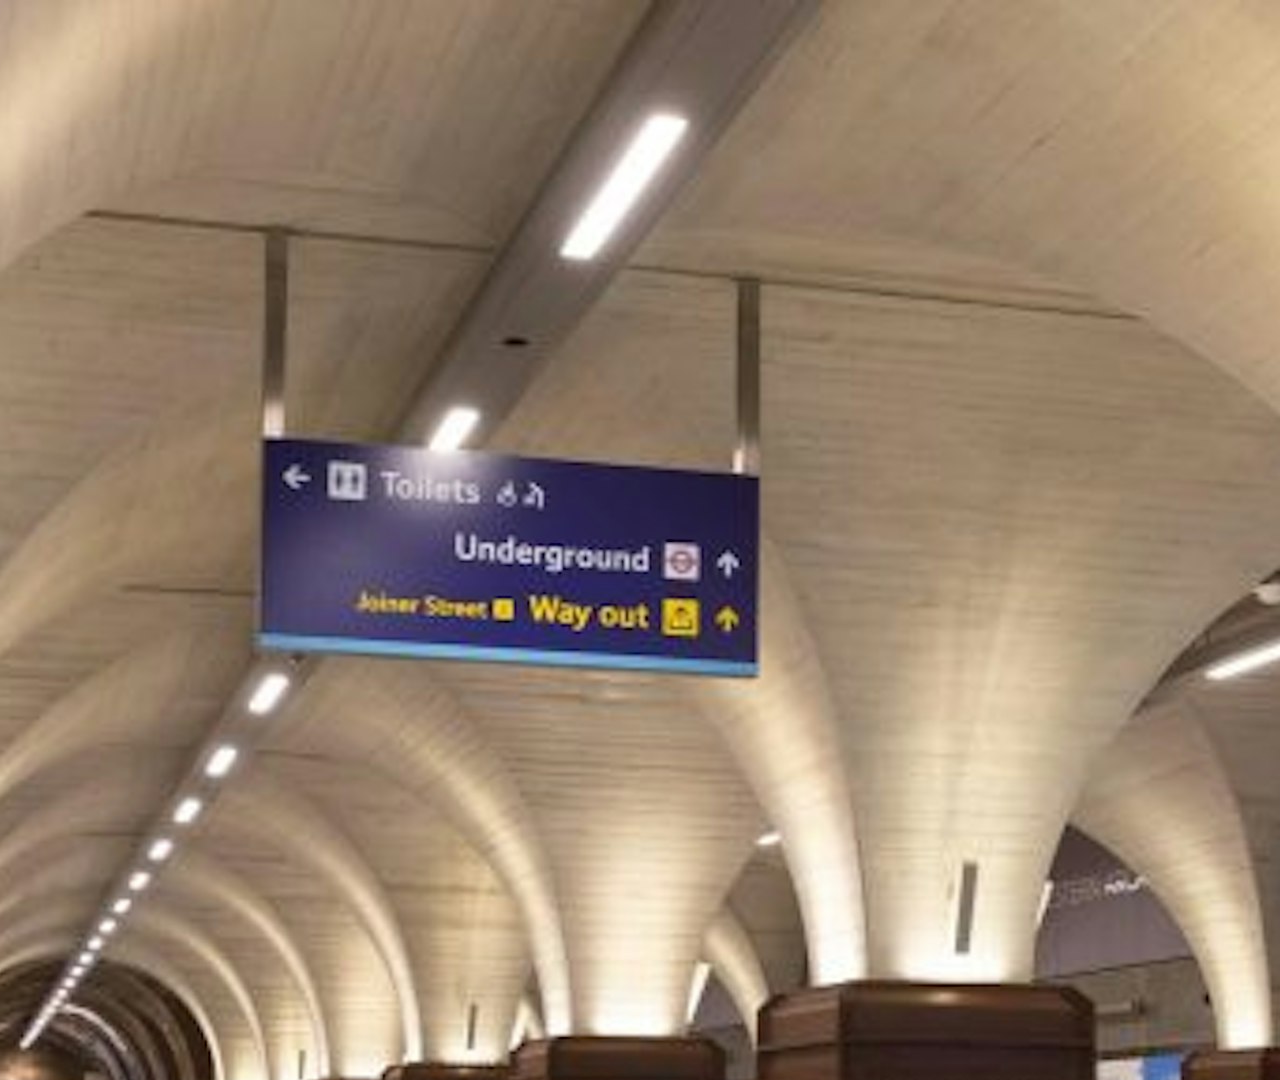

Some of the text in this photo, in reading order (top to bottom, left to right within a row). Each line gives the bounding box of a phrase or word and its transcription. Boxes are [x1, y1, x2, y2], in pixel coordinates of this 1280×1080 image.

[379, 470, 481, 505] Toilets
[453, 531, 651, 573] Underground
[356, 590, 650, 632] Joiner Street Way out
